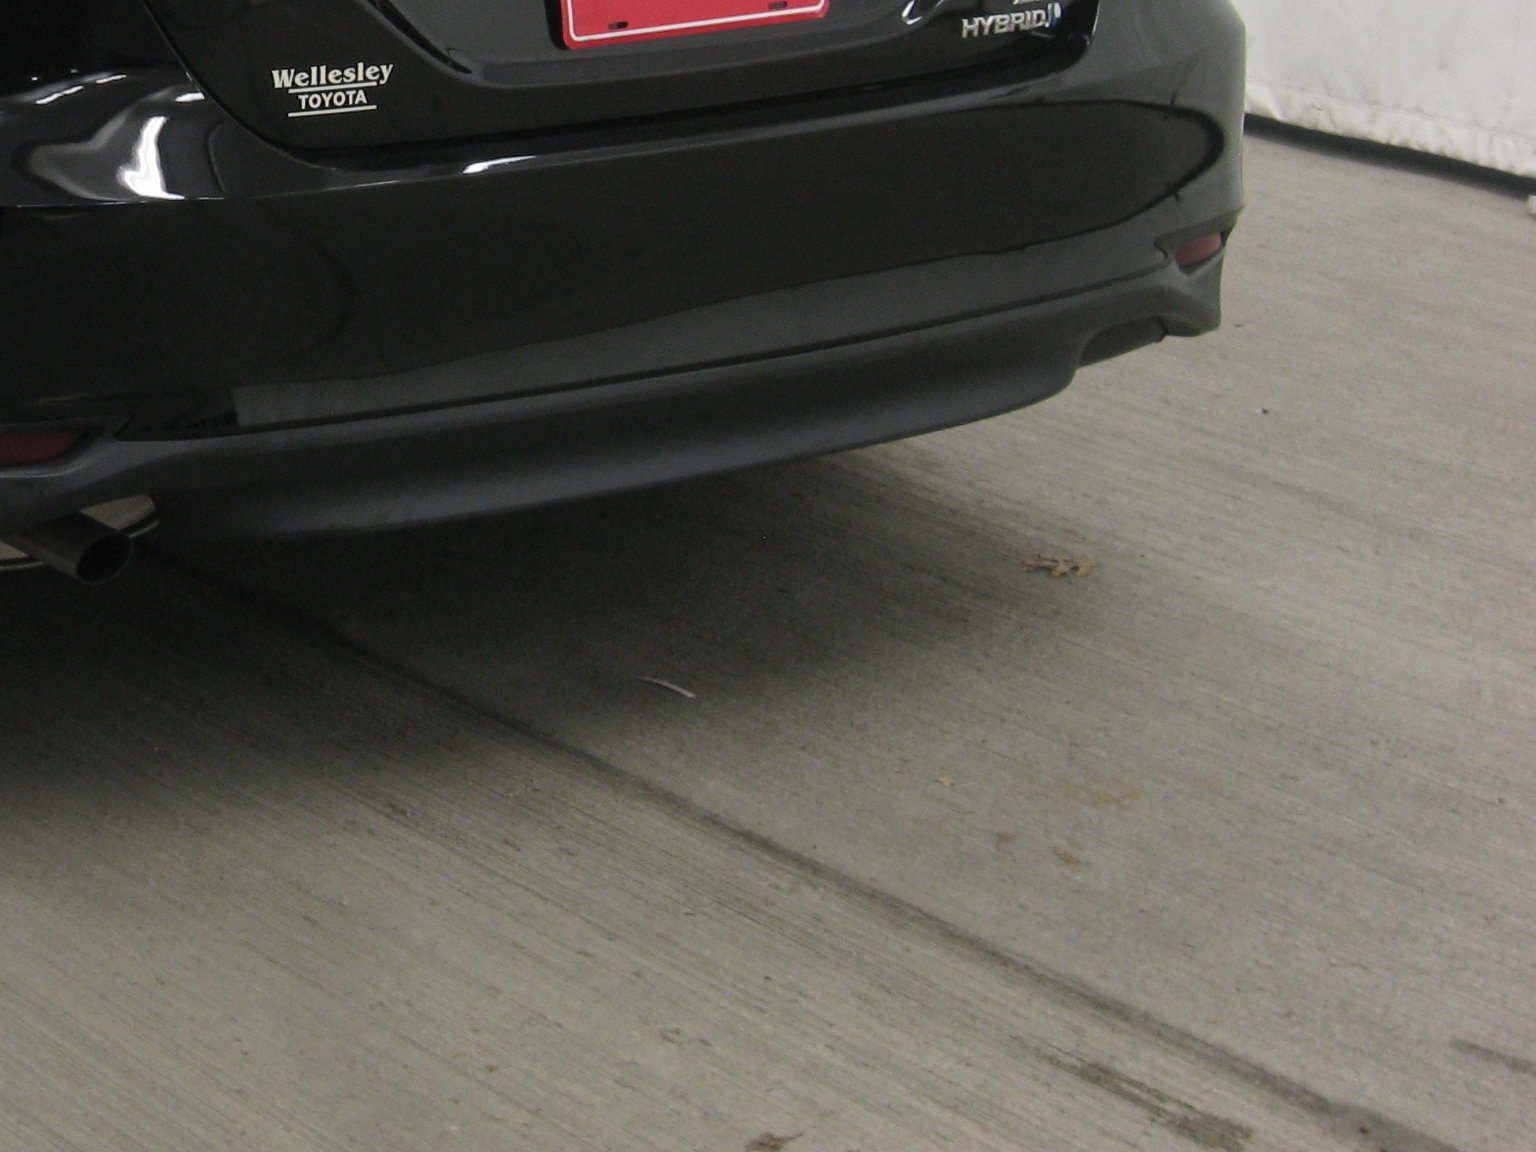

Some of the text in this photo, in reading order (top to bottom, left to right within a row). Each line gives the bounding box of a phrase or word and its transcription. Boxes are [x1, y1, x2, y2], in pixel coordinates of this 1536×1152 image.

[962, 9, 1047, 38] HYBRID
[272, 62, 393, 88] Wellesley
[298, 89, 367, 109] TOYOTA
